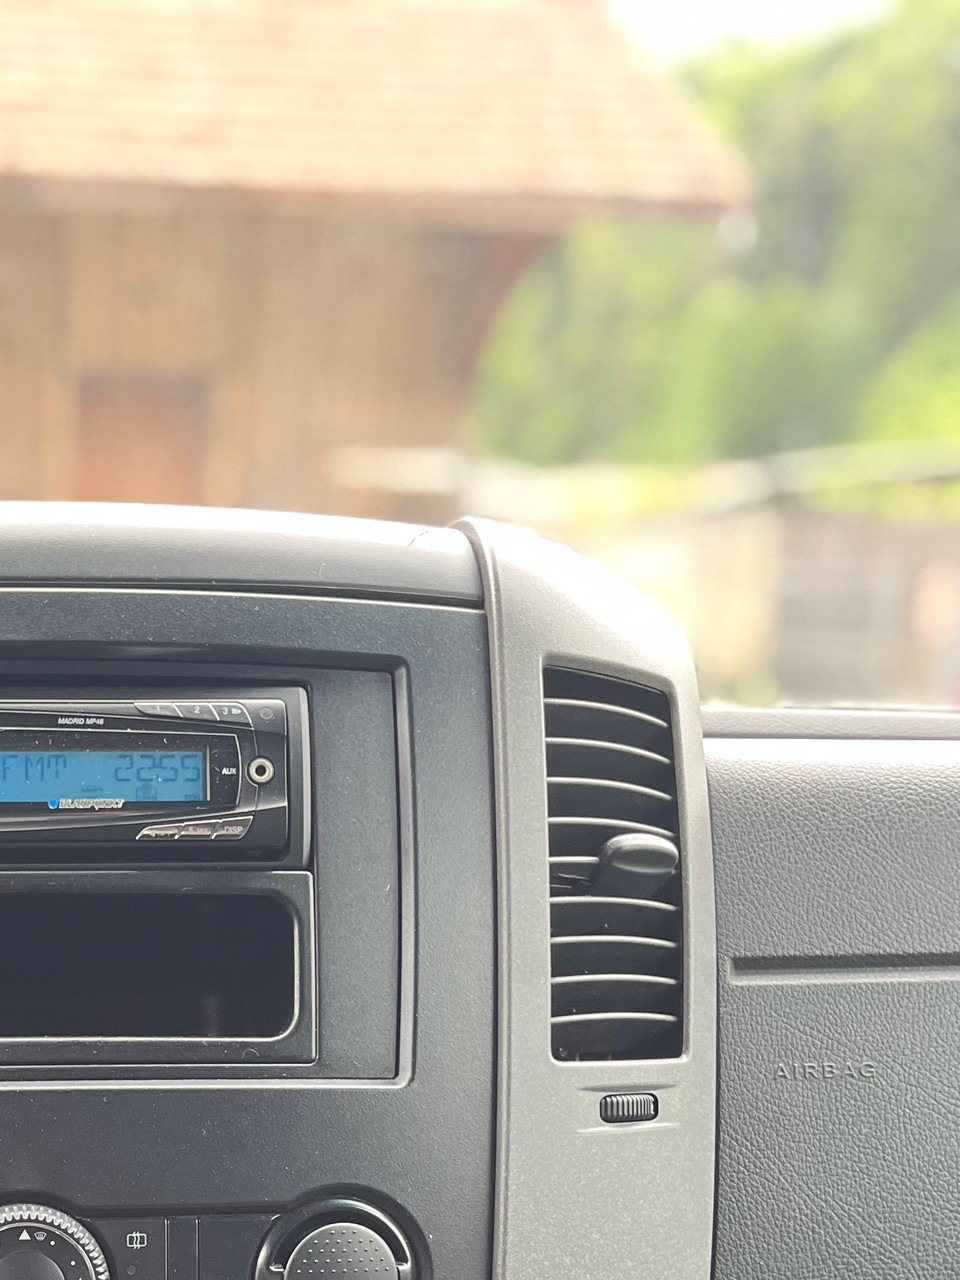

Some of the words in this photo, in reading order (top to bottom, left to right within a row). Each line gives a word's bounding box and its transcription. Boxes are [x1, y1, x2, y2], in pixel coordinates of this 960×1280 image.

[193, 706, 201, 714] 2
[222, 707, 229, 715] 3
[57, 717, 85, 725] MADRID
[221, 767, 237, 775] AUX
[58, 798, 125, 810] BLAUPUNKT
[224, 825, 243, 834] DISP
[775, 1061, 876, 1079] AIRBAG
